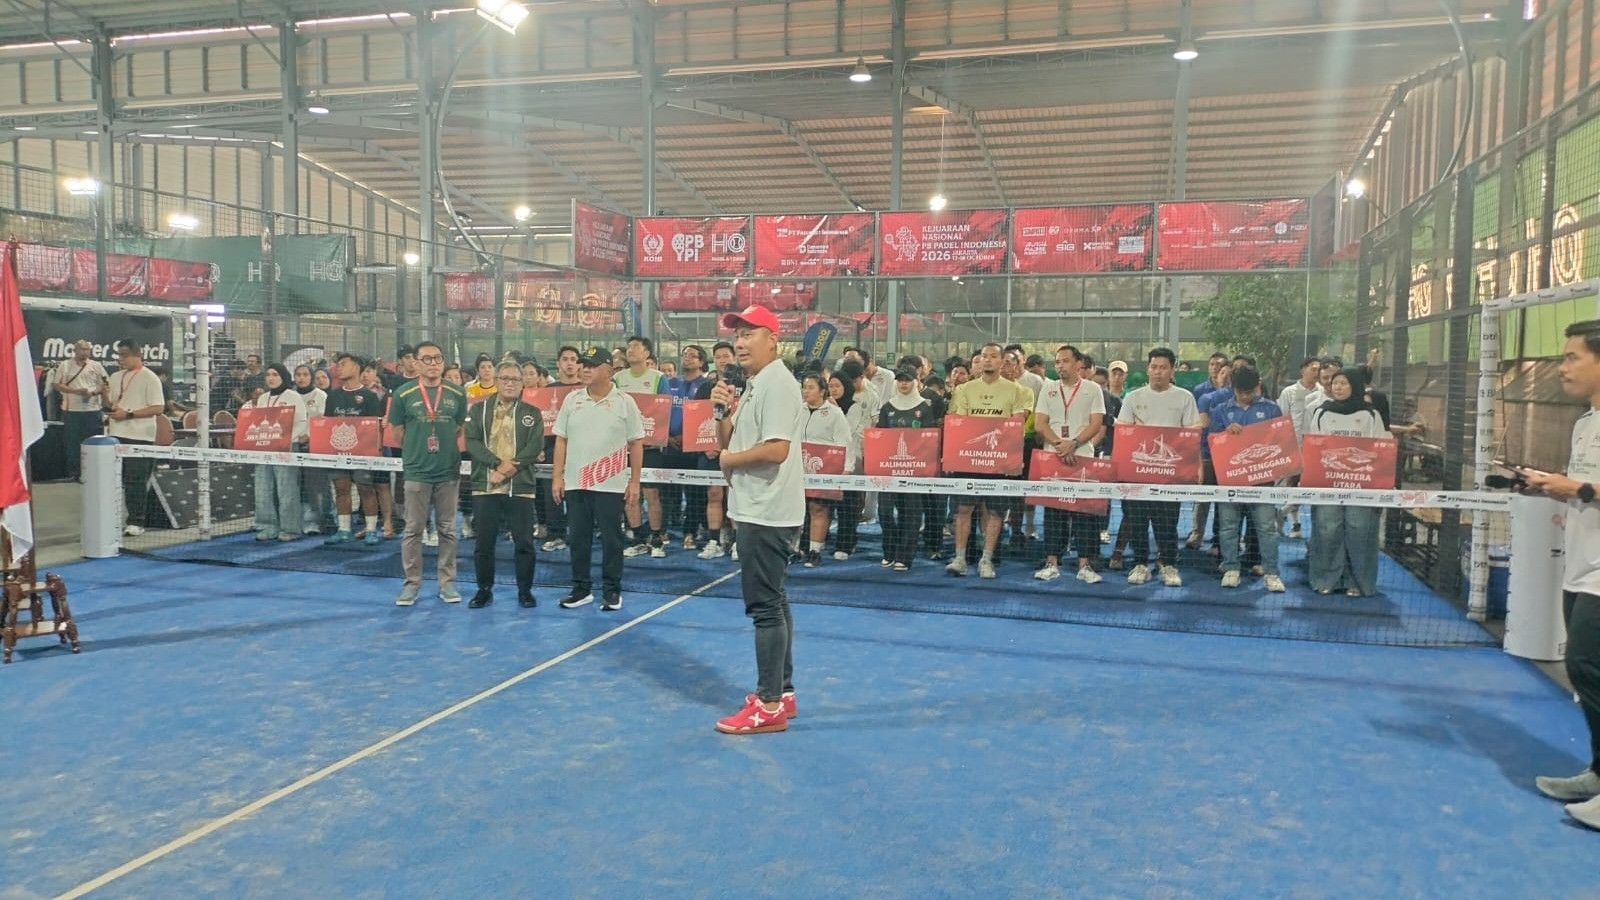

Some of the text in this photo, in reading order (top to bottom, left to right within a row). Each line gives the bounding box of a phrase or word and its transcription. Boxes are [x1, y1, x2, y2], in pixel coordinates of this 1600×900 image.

[922, 224, 970, 233] KEJUARAAN
[922, 233, 963, 241] NASIONAL
[711, 233, 746, 254] HQ
[933, 241, 958, 249] PADEL
[960, 240, 1007, 249] INDONESIA
[921, 250, 951, 262] 2026
[43, 338, 107, 358] Maer
[696, 437, 712, 445] JAWA
[959, 449, 1007, 458] KALIMANTAN
[879, 460, 926, 469] KALIMANTAN
[970, 459, 995, 467] TIMUR
[1226, 456, 1292, 478] NUSA TENGGARA
[1135, 466, 1175, 476] LAMPUNG
[1324, 470, 1371, 482] SUMATERA
[1247, 470, 1273, 483] BARAT
[1332, 479, 1361, 489] UTARA
